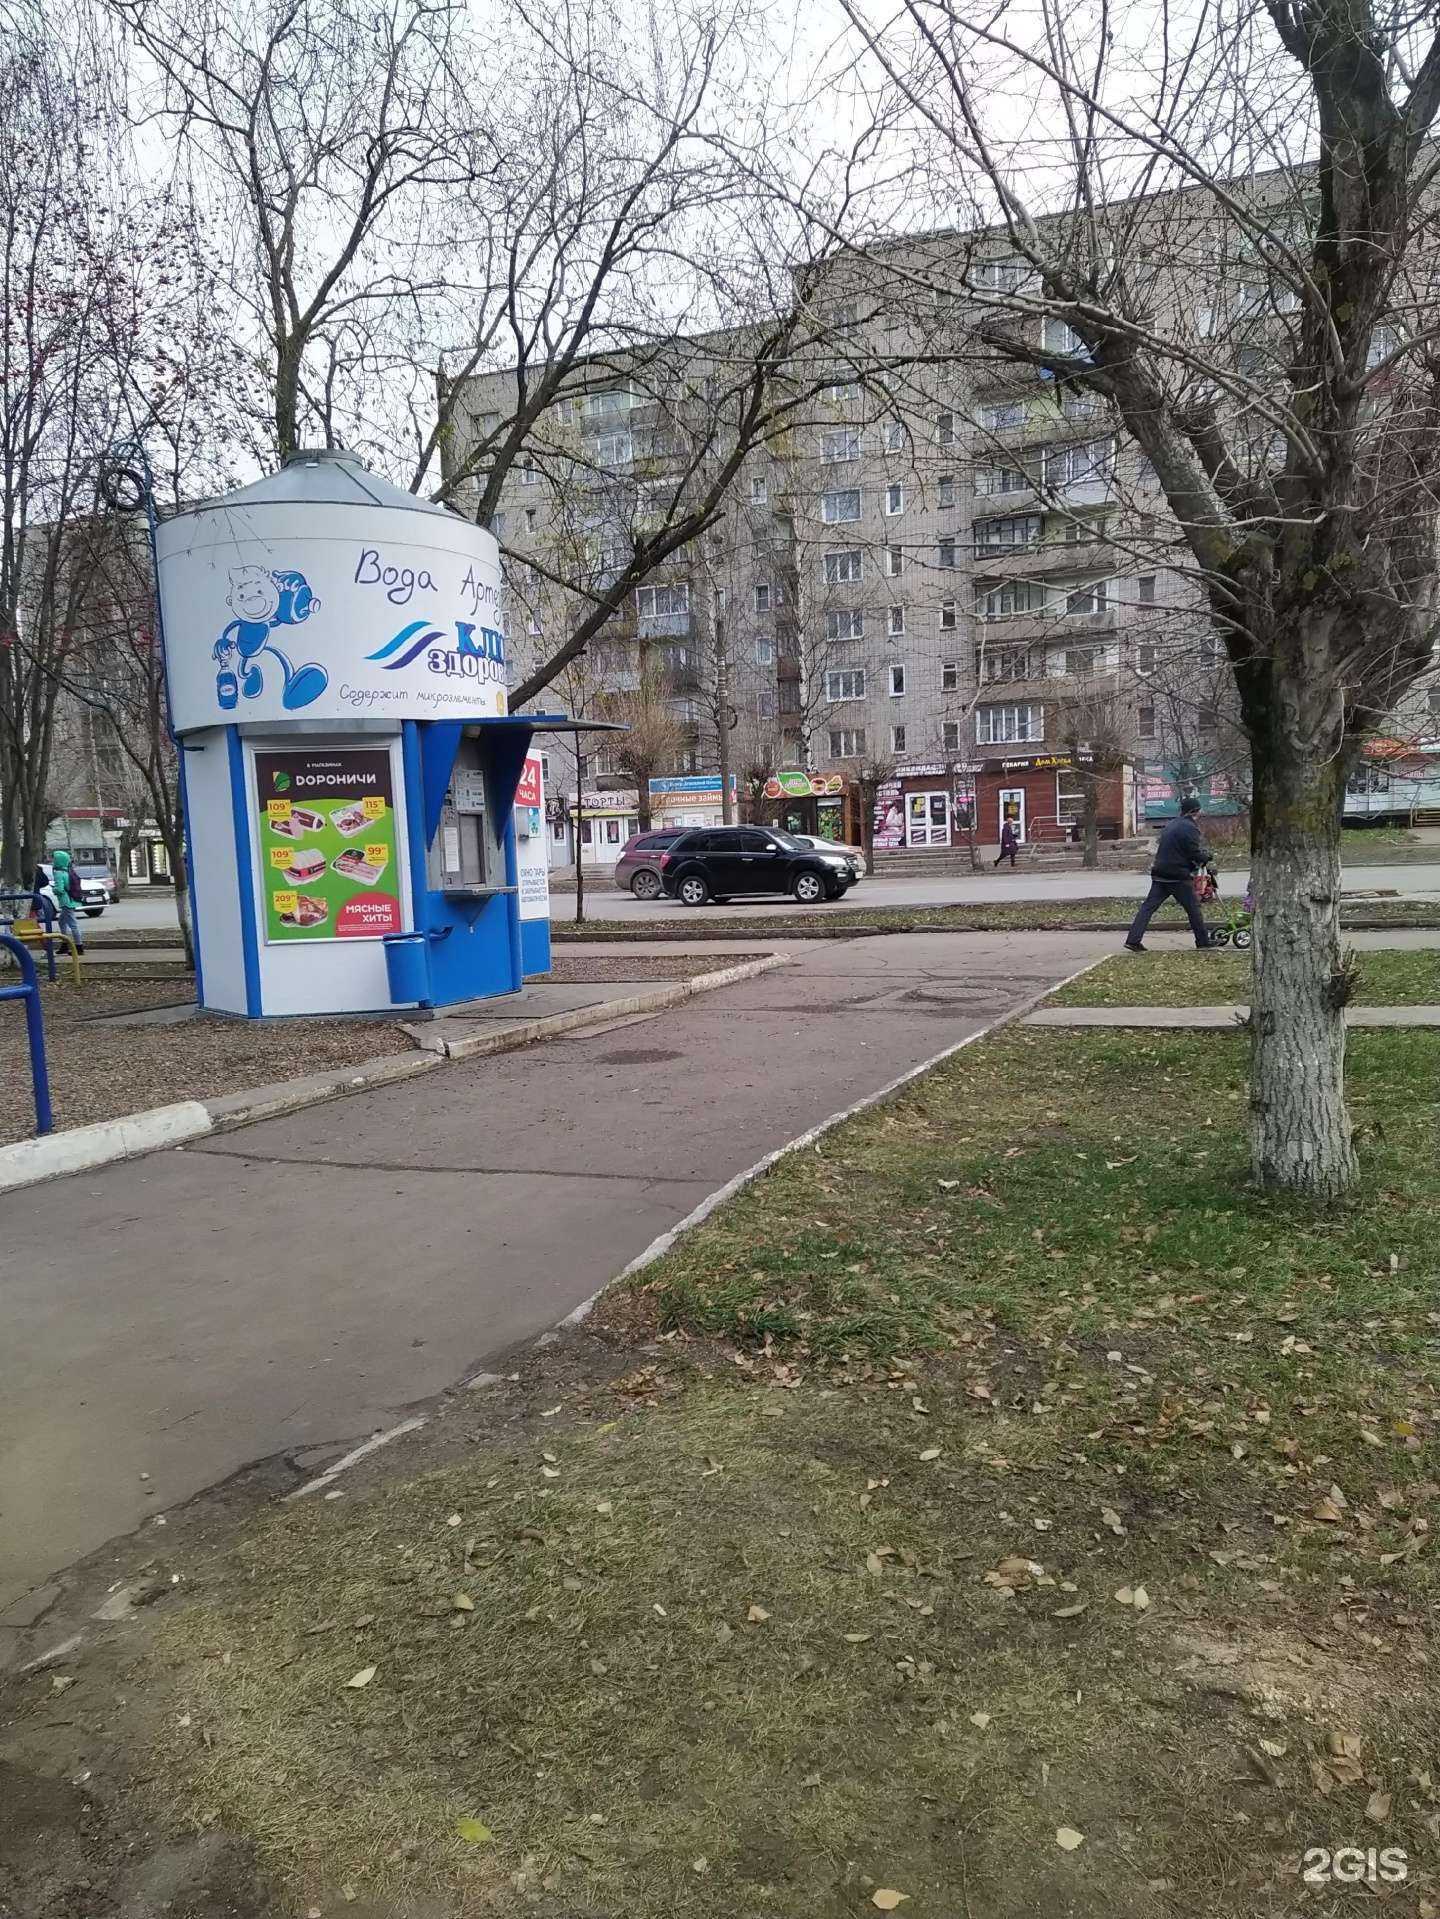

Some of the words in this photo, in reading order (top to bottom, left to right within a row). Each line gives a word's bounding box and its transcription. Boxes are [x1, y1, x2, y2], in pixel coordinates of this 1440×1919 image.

[355, 547, 438, 605] Вода
[340, 684, 408, 707] Содержит
[295, 774, 377, 786] ДОРОНИЧИ
[519, 789, 536, 801] ЧАСА
[584, 796, 625, 808] ТОРТЫ
[345, 904, 392, 915] МЯСНЫЕ
[362, 913, 393, 923] ХИТЫ
